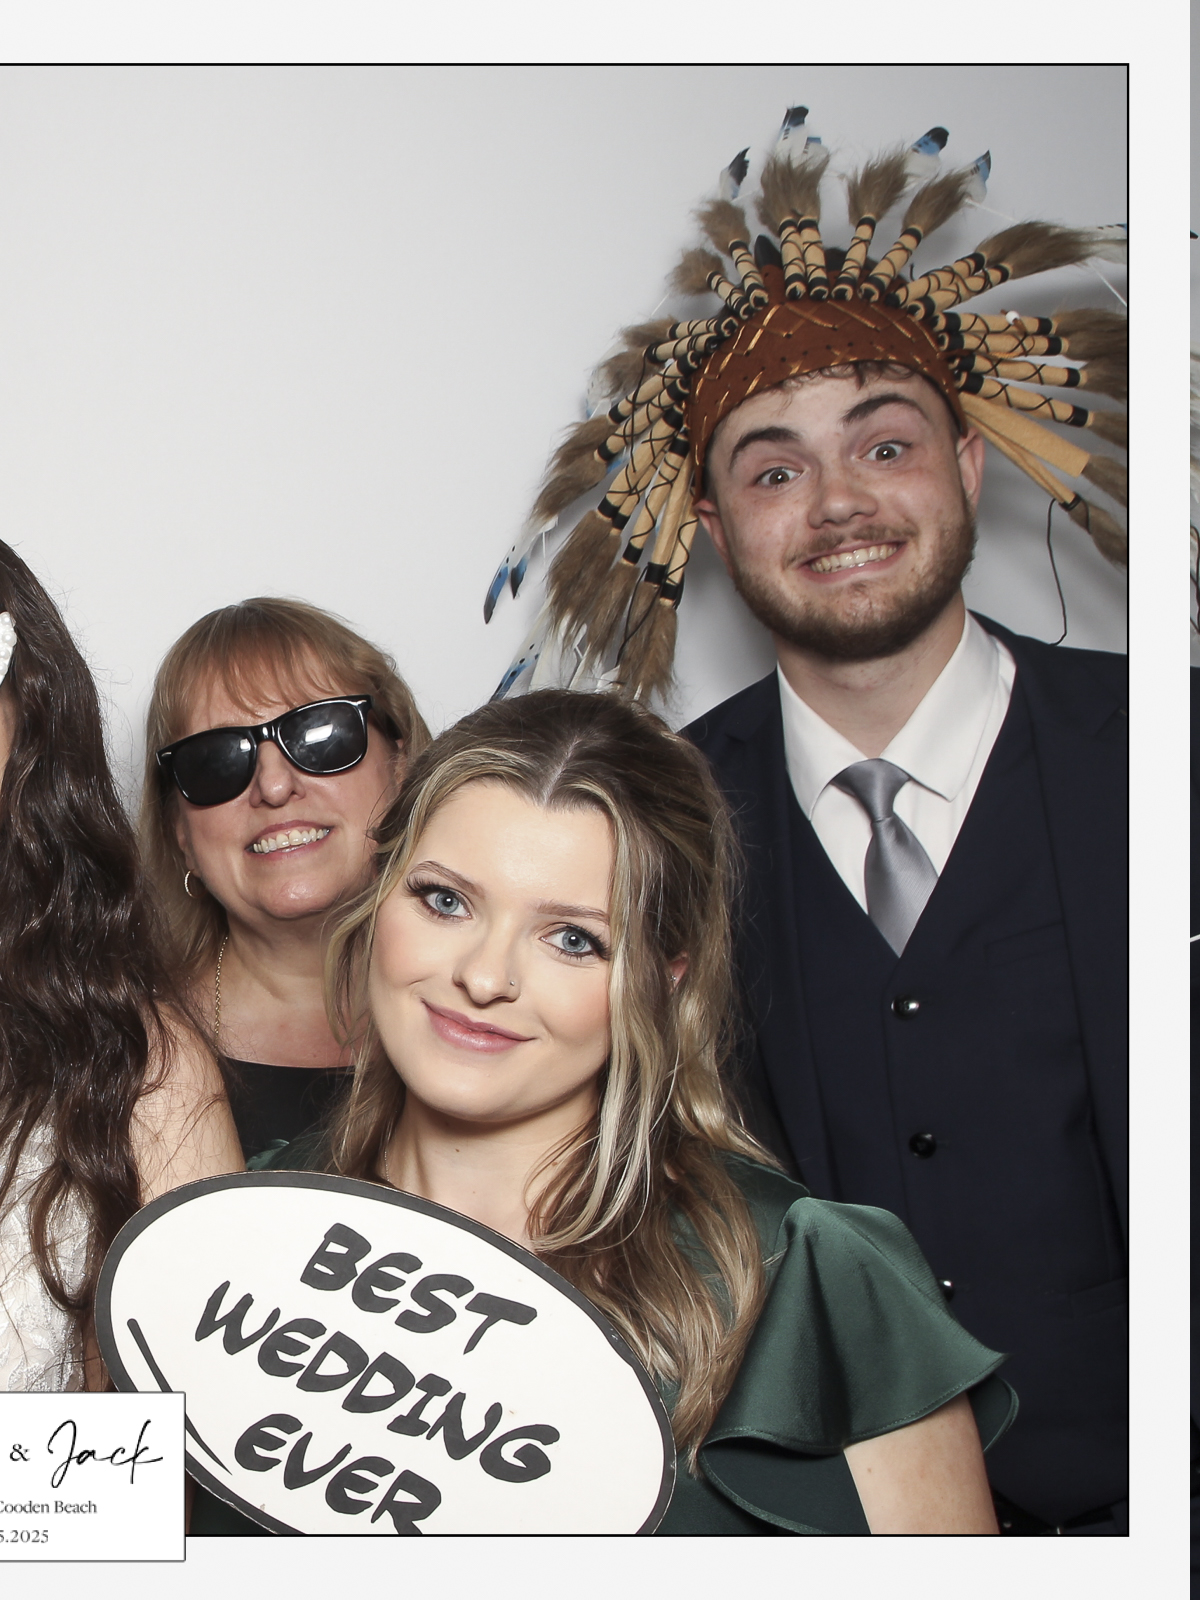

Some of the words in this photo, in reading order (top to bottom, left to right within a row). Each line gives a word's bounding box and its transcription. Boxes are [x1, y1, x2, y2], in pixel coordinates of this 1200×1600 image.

[299, 1222, 538, 1355] BEST
[194, 1280, 561, 1484] WEDDING
[234, 1413, 442, 1534] EVER
